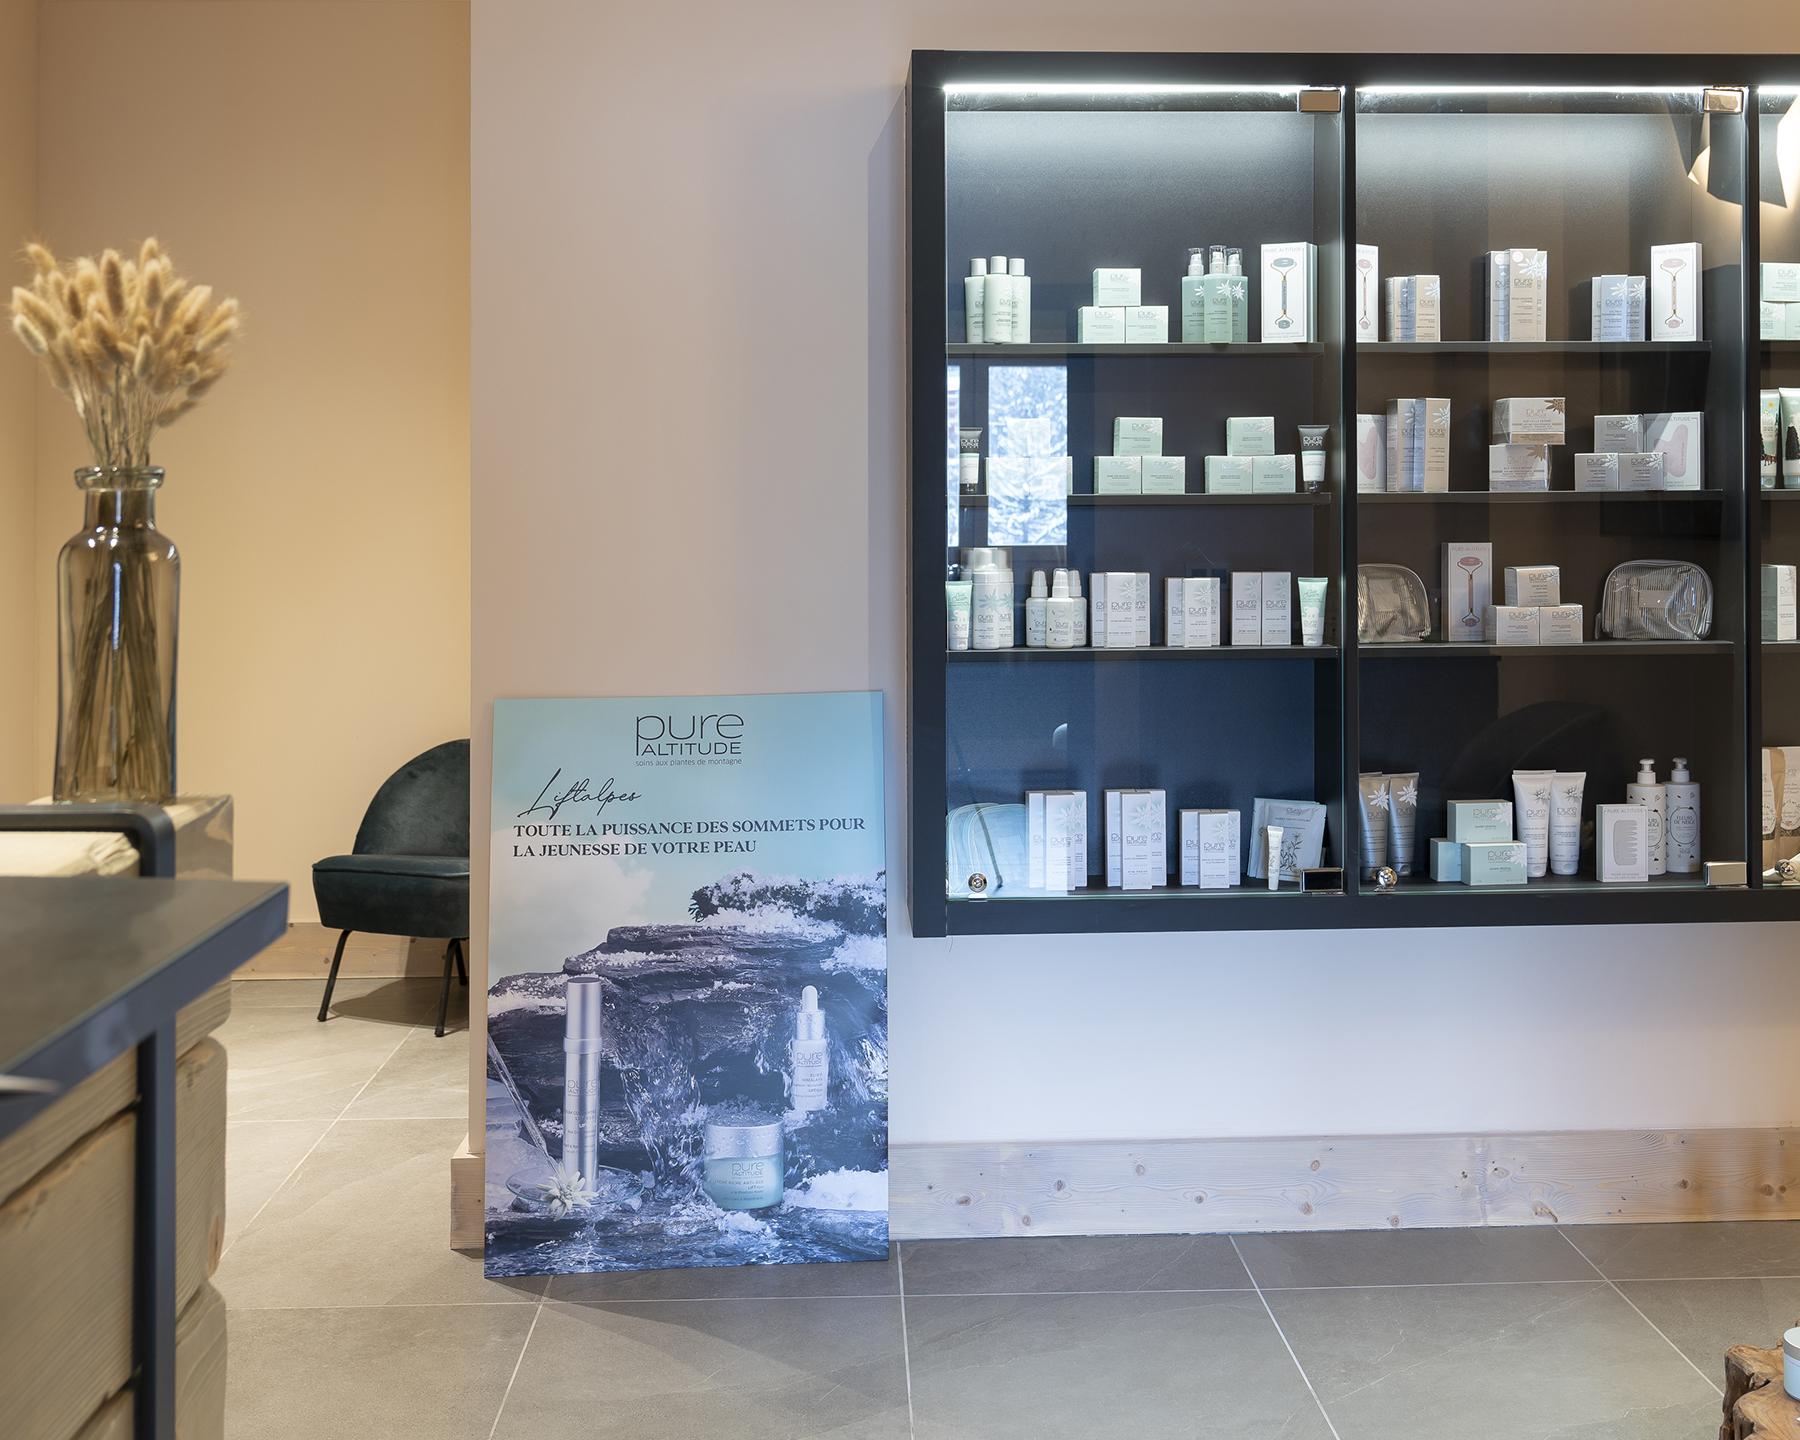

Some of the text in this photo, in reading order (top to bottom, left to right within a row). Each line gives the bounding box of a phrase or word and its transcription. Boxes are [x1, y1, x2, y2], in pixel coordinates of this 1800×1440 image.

[1111, 601, 1133, 611] pure
[1236, 600, 1257, 609] pure
[1266, 600, 1288, 609] pure
[1189, 607, 1208, 617] pure
[636, 714, 744, 756] pure
[641, 742, 742, 756] ALTITUDE
[670, 759, 695, 768] plantes
[708, 758, 742, 768] montagne
[1472, 808, 1498, 819] pure
[514, 817, 866, 837] TOUTE LA PUISSANCE DES SOMMETS POUR
[1126, 835, 1148, 846] pure
[513, 840, 756, 858] LA JEUNESSE DE VOTRE PEAU
[1203, 842, 1226, 852] pure
[1488, 850, 1512, 863] pure
[797, 1051, 823, 1065] pure
[732, 1162, 764, 1176] pure
